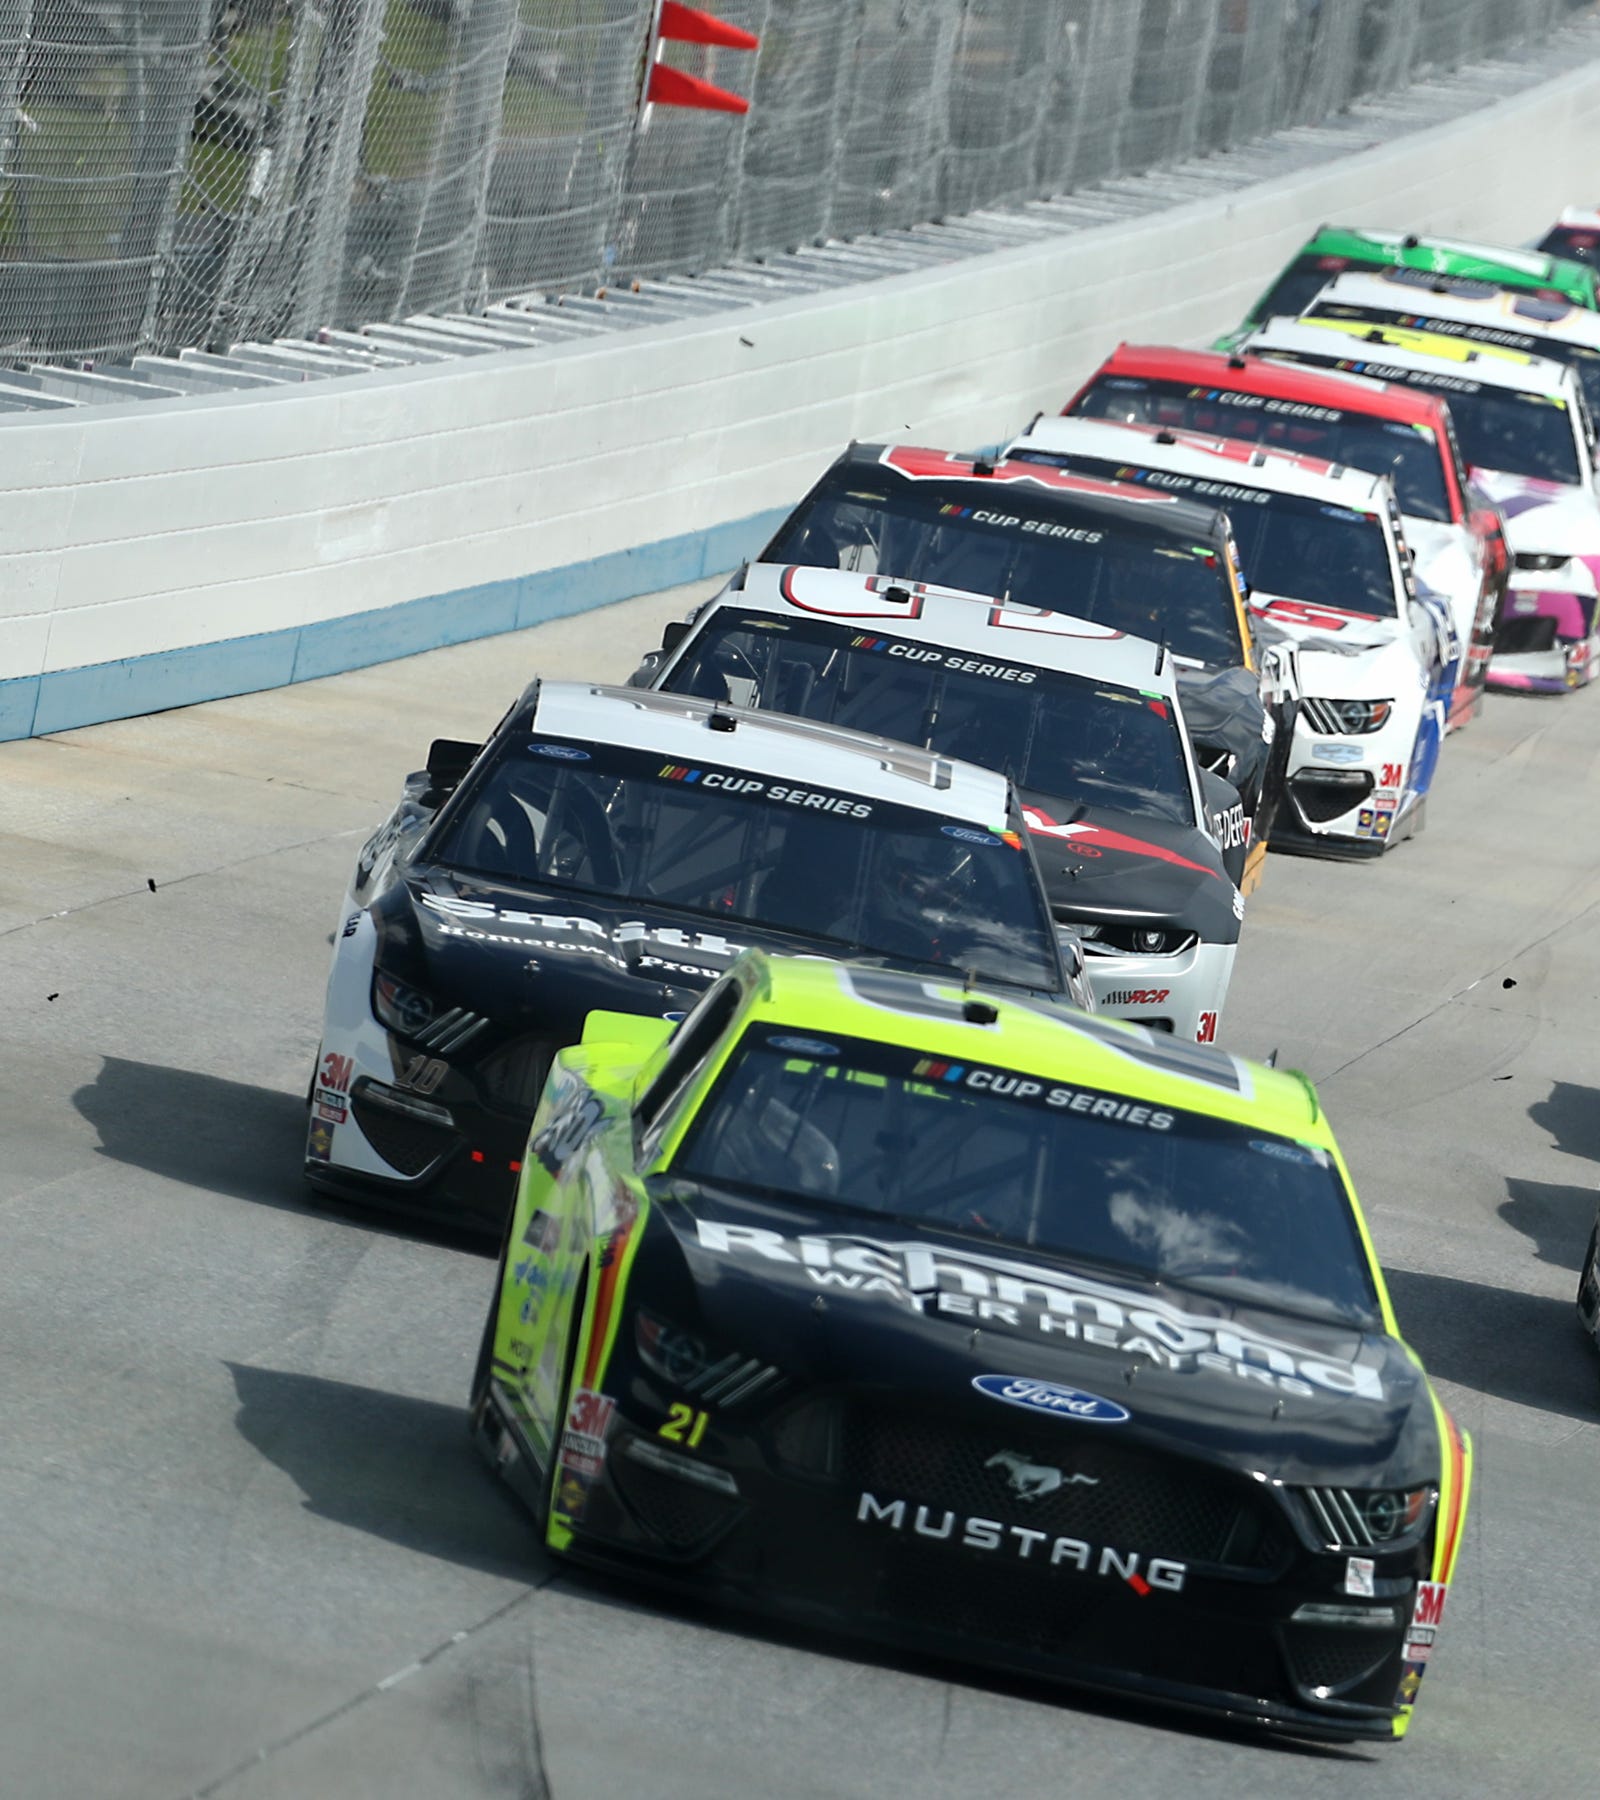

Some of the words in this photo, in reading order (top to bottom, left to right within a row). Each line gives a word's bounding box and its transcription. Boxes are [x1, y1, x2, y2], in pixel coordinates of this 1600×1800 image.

[1425, 319, 1465, 336] CUP
[1466, 328, 1535, 349] SERIES
[1364, 363, 1406, 380] CUP
[1408, 371, 1482, 394] SERIES
[1218, 391, 1263, 407] CUP
[1265, 400, 1343, 422] SERIES
[1147, 472, 1191, 489] CUP
[1194, 480, 1271, 503] SERIES
[972, 510, 1021, 528] CUP
[1022, 519, 1104, 544] SERIES
[888, 643, 942, 665] CUP
[944, 656, 1037, 685] SERIES
[702, 773, 764, 794] CUP
[766, 786, 873, 818] SERIES
[1380, 763, 1402, 787] 3M
[420, 892, 750, 956] Smith
[437, 923, 629, 968] Hometown
[638, 954, 722, 979] Prou
[1126, 989, 1170, 1004] RCR
[319, 1051, 354, 1093] 3M
[396, 1054, 449, 1095] 10
[966, 1070, 1041, 1098] CUP
[1045, 1088, 1176, 1131] SERIES
[696, 1218, 1384, 1400] Richmond
[806, 1268, 1021, 1326] WATER
[1039, 1311, 1315, 1398] HEATERS
[658, 1402, 709, 1448] 21
[857, 1491, 1188, 1592] MUSTANG
[1414, 1585, 1446, 1625] 3M
